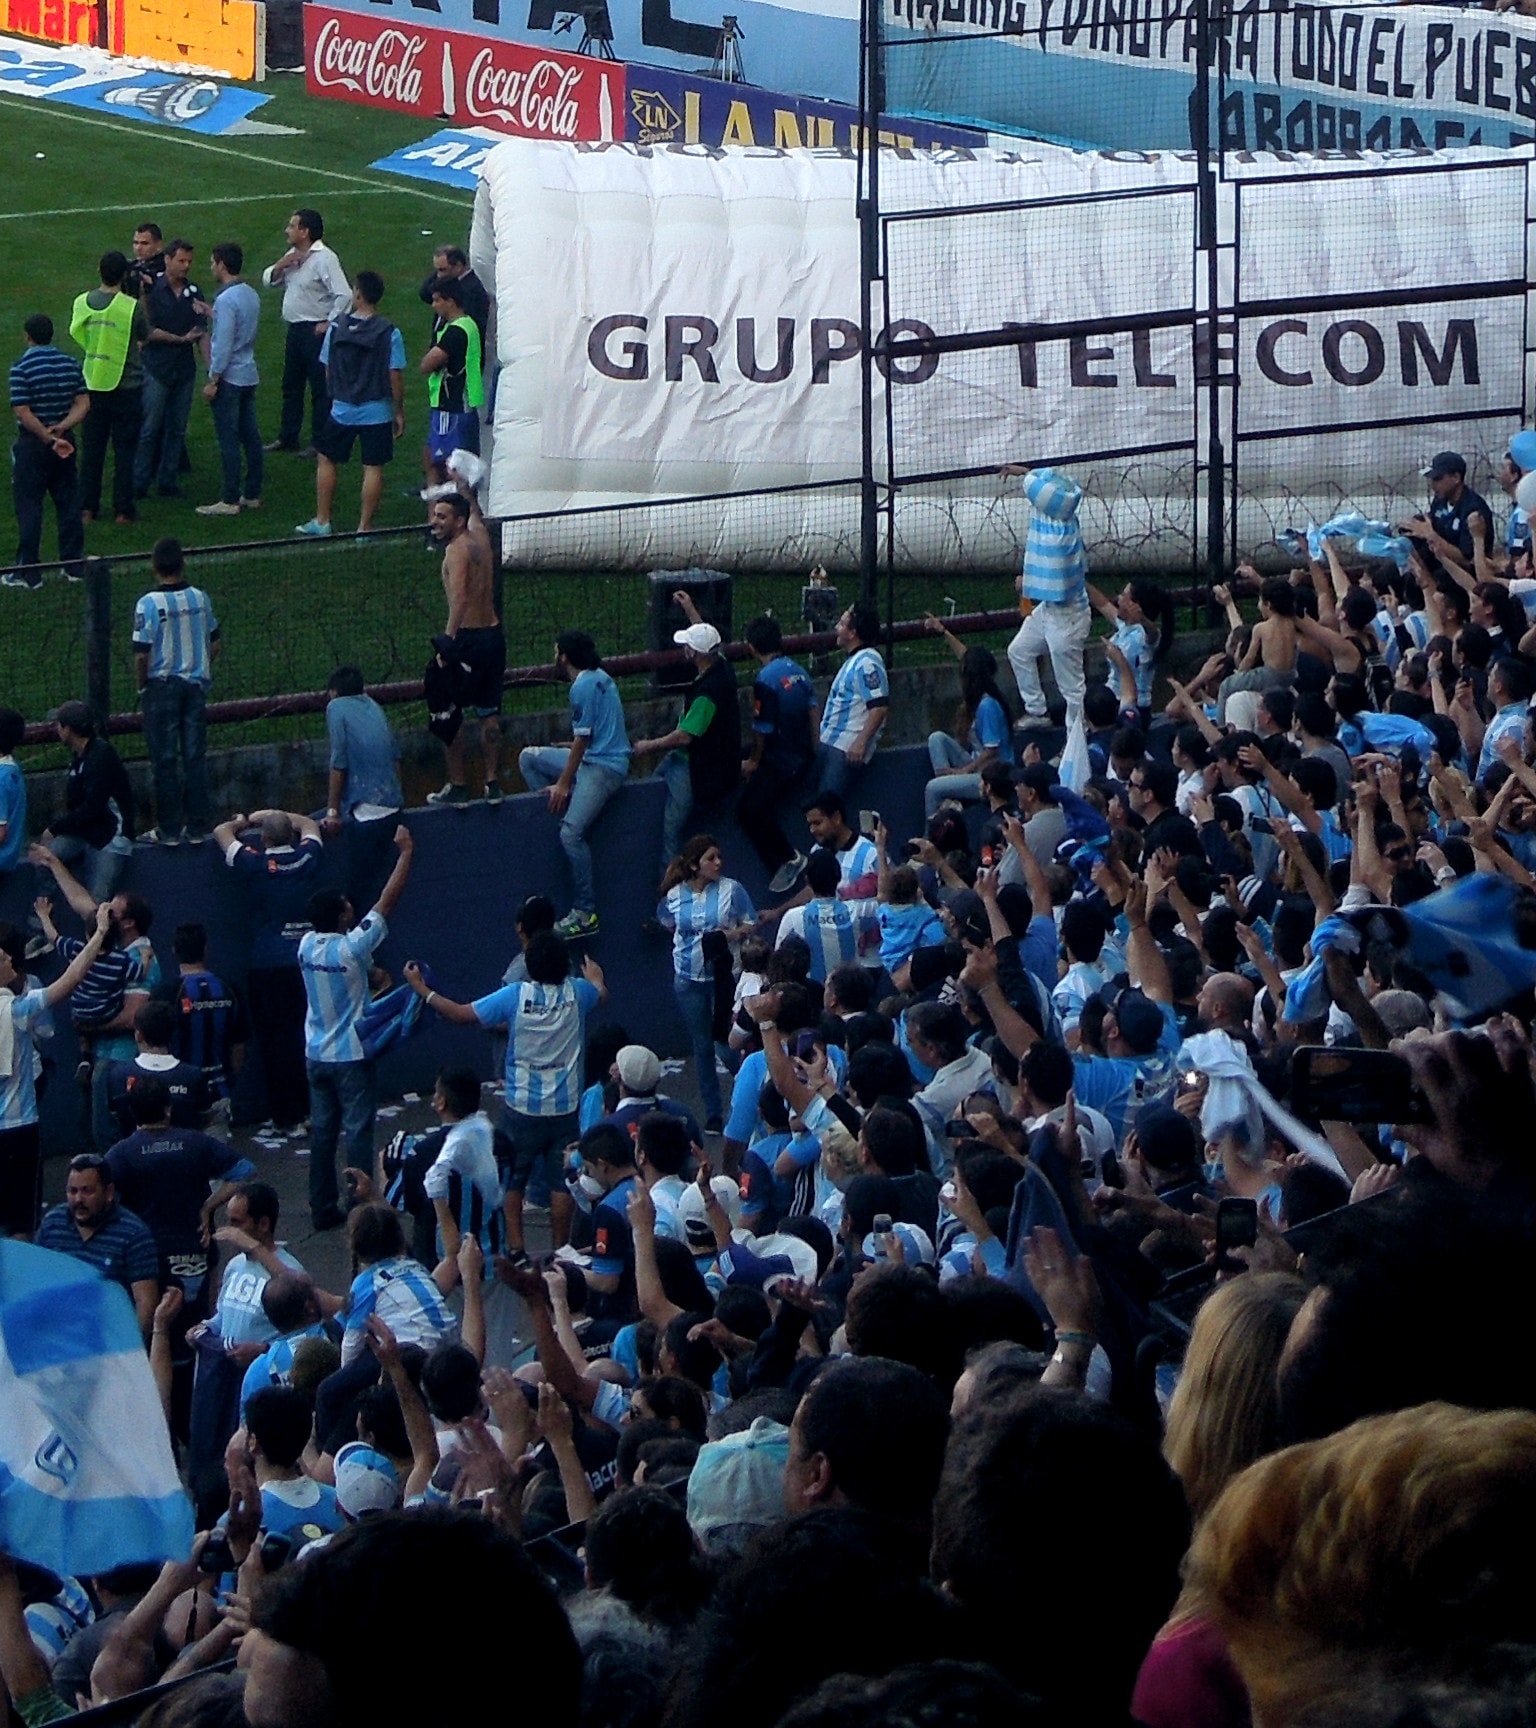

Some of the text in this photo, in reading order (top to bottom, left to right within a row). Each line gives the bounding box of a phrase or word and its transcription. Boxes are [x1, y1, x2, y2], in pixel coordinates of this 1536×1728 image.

[1366, 17, 1416, 99] EL
[586, 314, 1482, 389] GRUPO TELECOM
